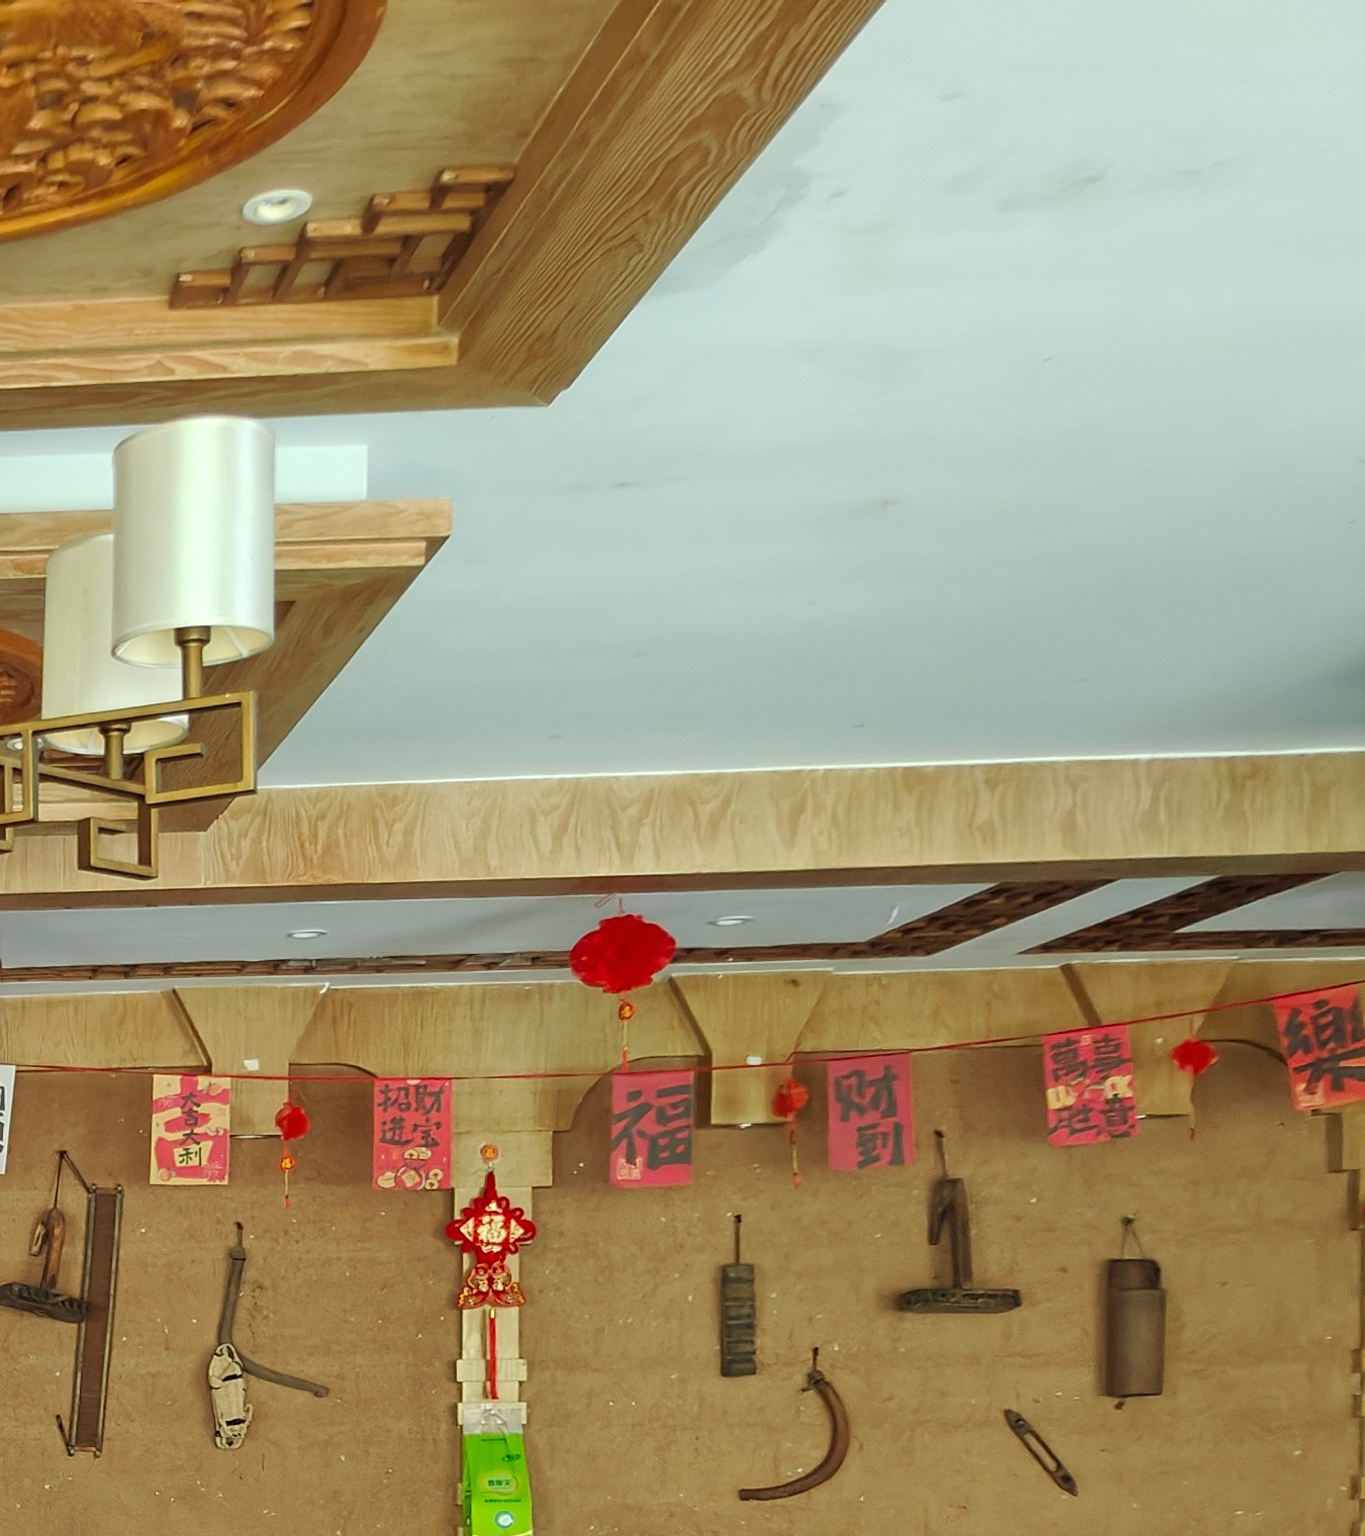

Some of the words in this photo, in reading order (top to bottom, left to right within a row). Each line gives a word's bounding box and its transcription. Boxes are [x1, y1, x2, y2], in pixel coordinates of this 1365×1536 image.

[179, 1091, 202, 1166] 大吉大利
[612, 1083, 693, 1171] 福
